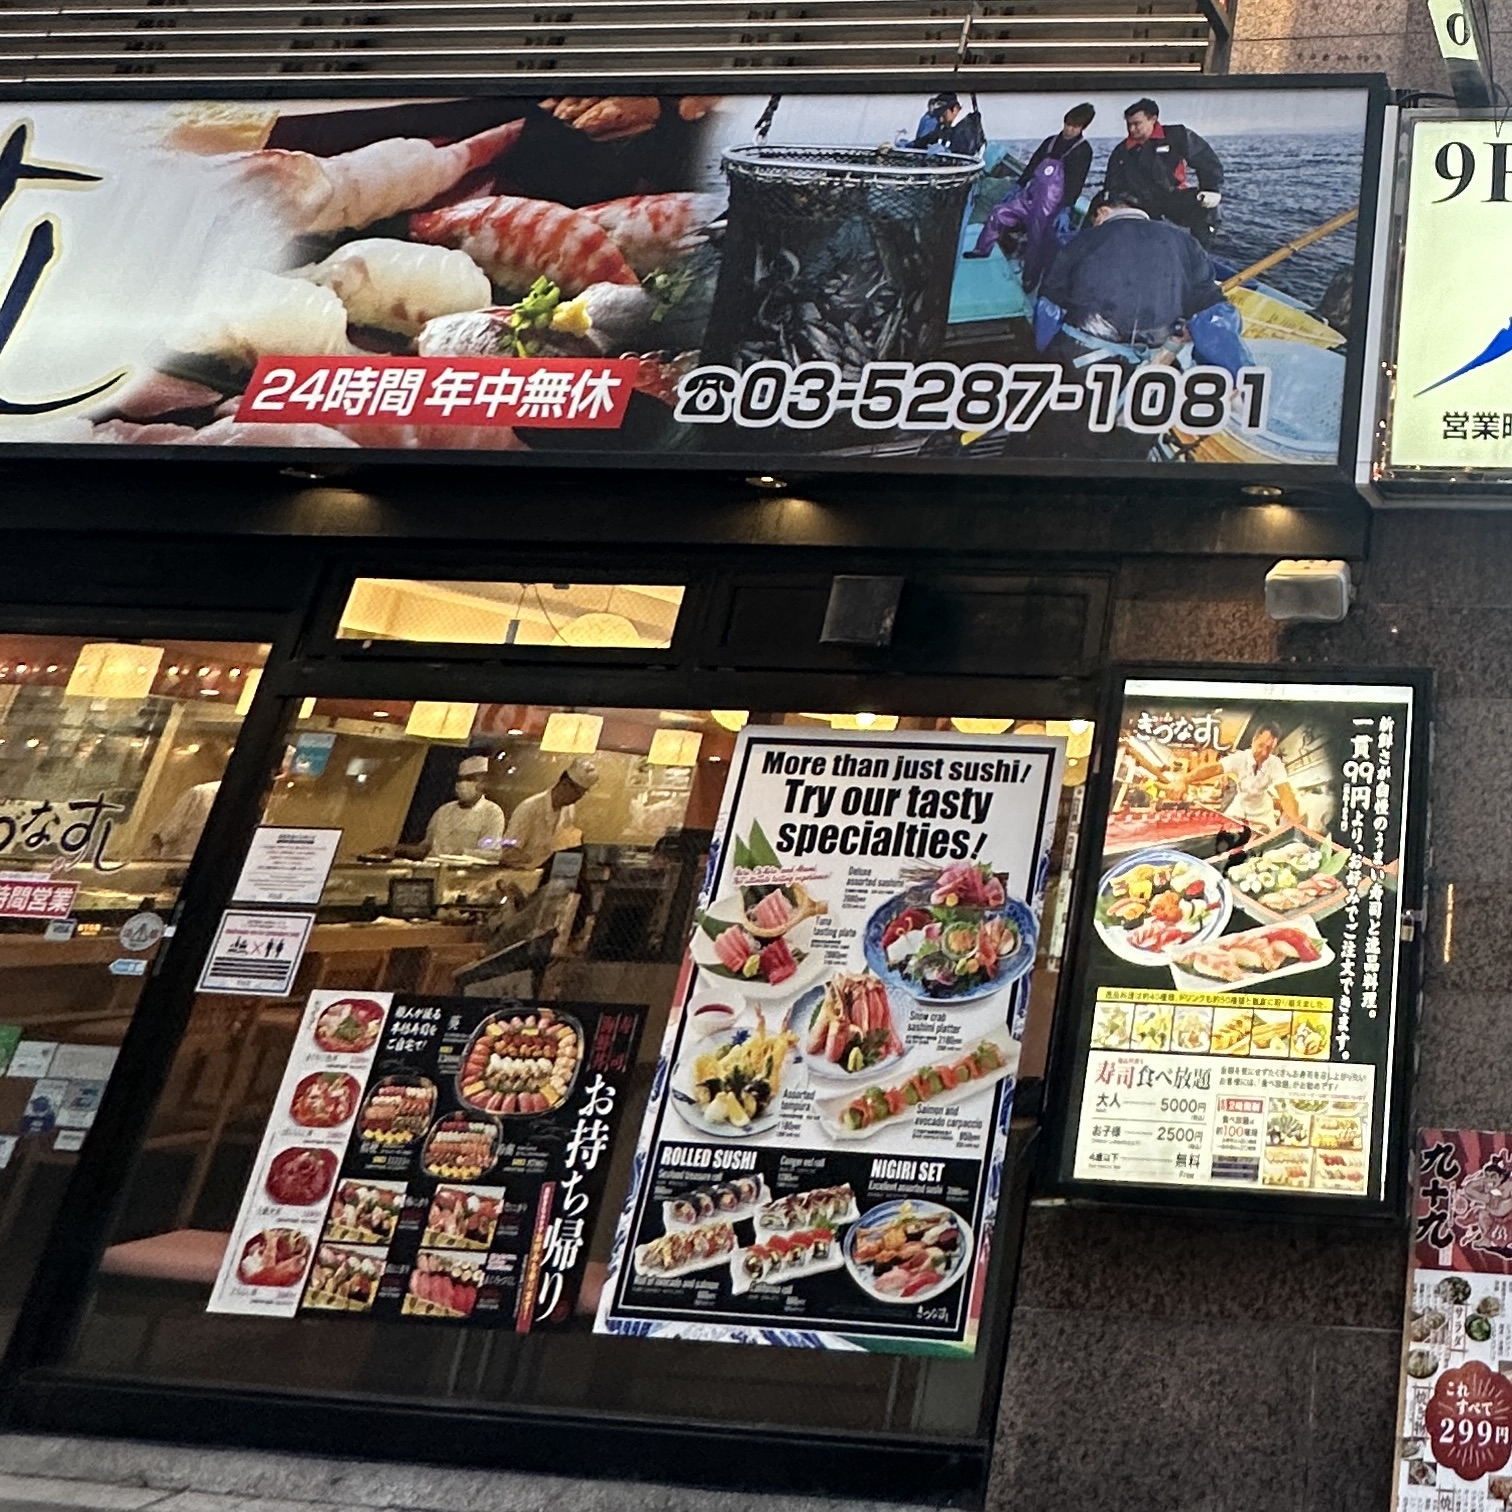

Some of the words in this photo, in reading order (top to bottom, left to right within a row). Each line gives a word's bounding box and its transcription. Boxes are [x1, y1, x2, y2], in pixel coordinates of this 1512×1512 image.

[252, 369, 416, 416] 24時間
[424, 368, 624, 418] 年中無休
[736, 364, 1268, 434] 03-5287-1081
[762, 751, 826, 777] More
[832, 753, 888, 778] than
[893, 755, 943, 781] just
[948, 758, 1031, 783] sushi!
[783, 779, 838, 817] Try
[841, 783, 900, 817] our
[906, 785, 993, 823] tasty
[776, 819, 988, 860] specialties!
[1095, 1059, 1211, 1090] 寿司食べ放題
[1096, 1094, 1121, 1108] 大人
[1160, 1098, 1207, 1114] 5000円
[1157, 1126, 1204, 1142] 2500円
[661, 1147, 712, 1168] ROLLED
[712, 1150, 758, 1170] SUSHI
[871, 1159, 916, 1180] NIGIRI
[918, 1162, 945, 1182] SET
[535, 1074, 616, 1323] お持ち帰り
[1416, 1142, 1458, 1249] 九十九
[1446, 1381, 1470, 1396] これ
[1457, 1400, 1493, 1416] すべて
[1440, 1418, 1509, 1446] 299円
